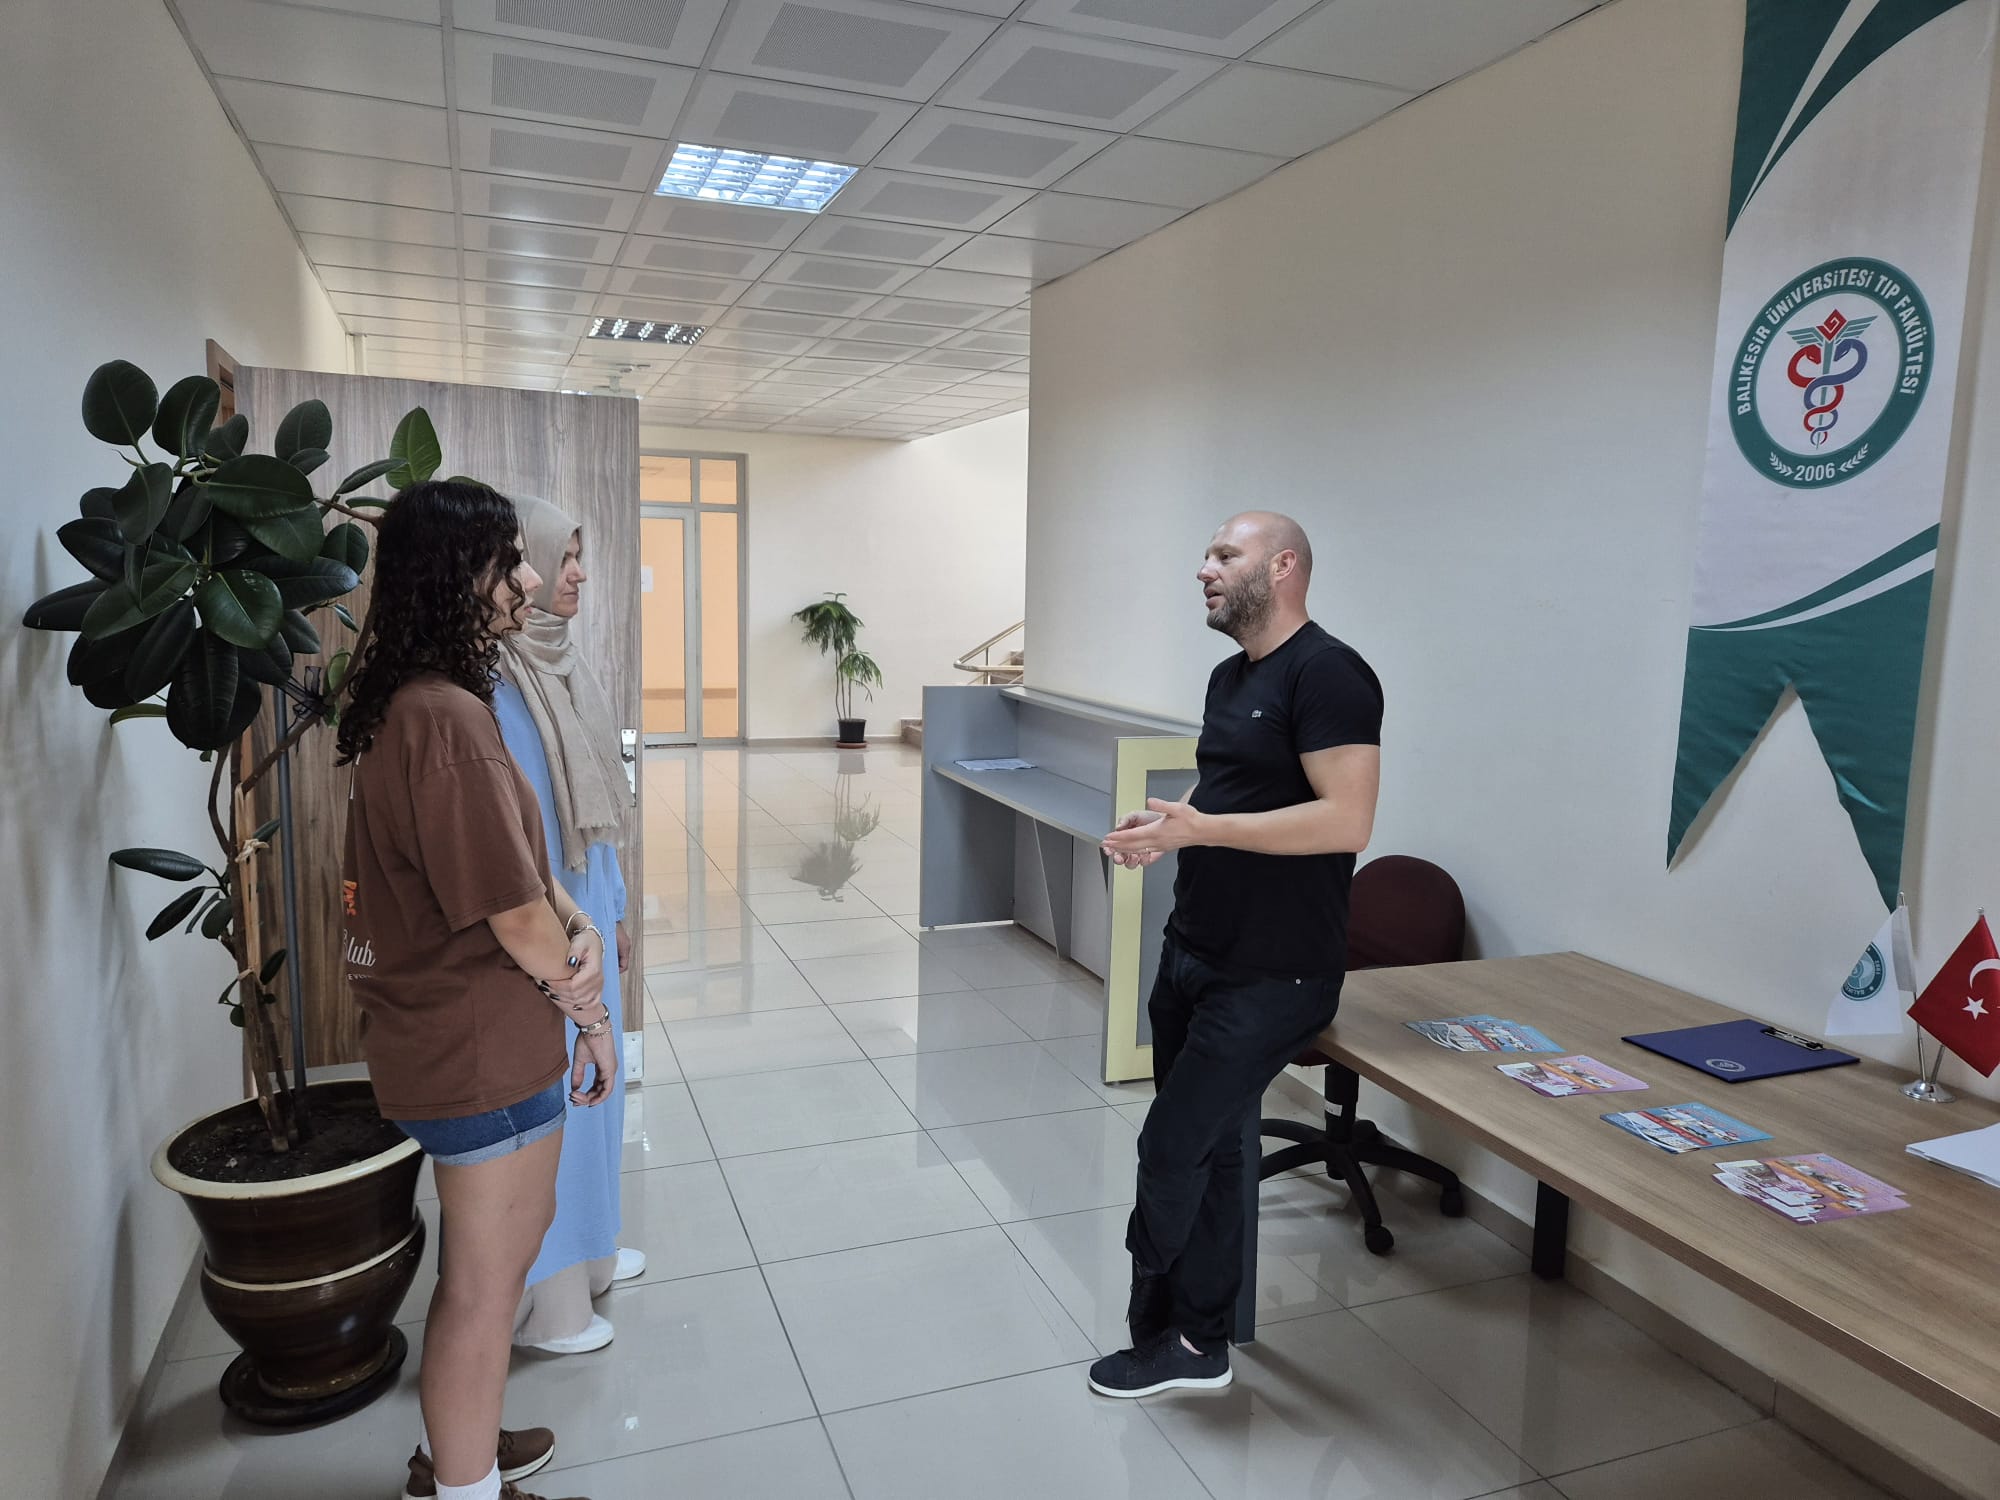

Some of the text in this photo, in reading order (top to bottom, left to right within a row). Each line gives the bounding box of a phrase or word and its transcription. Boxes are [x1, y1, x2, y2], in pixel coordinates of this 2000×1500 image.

[1876, 274, 1901, 300] TIP
[1794, 462, 1836, 482] 2006
[343, 929, 376, 967] lub
